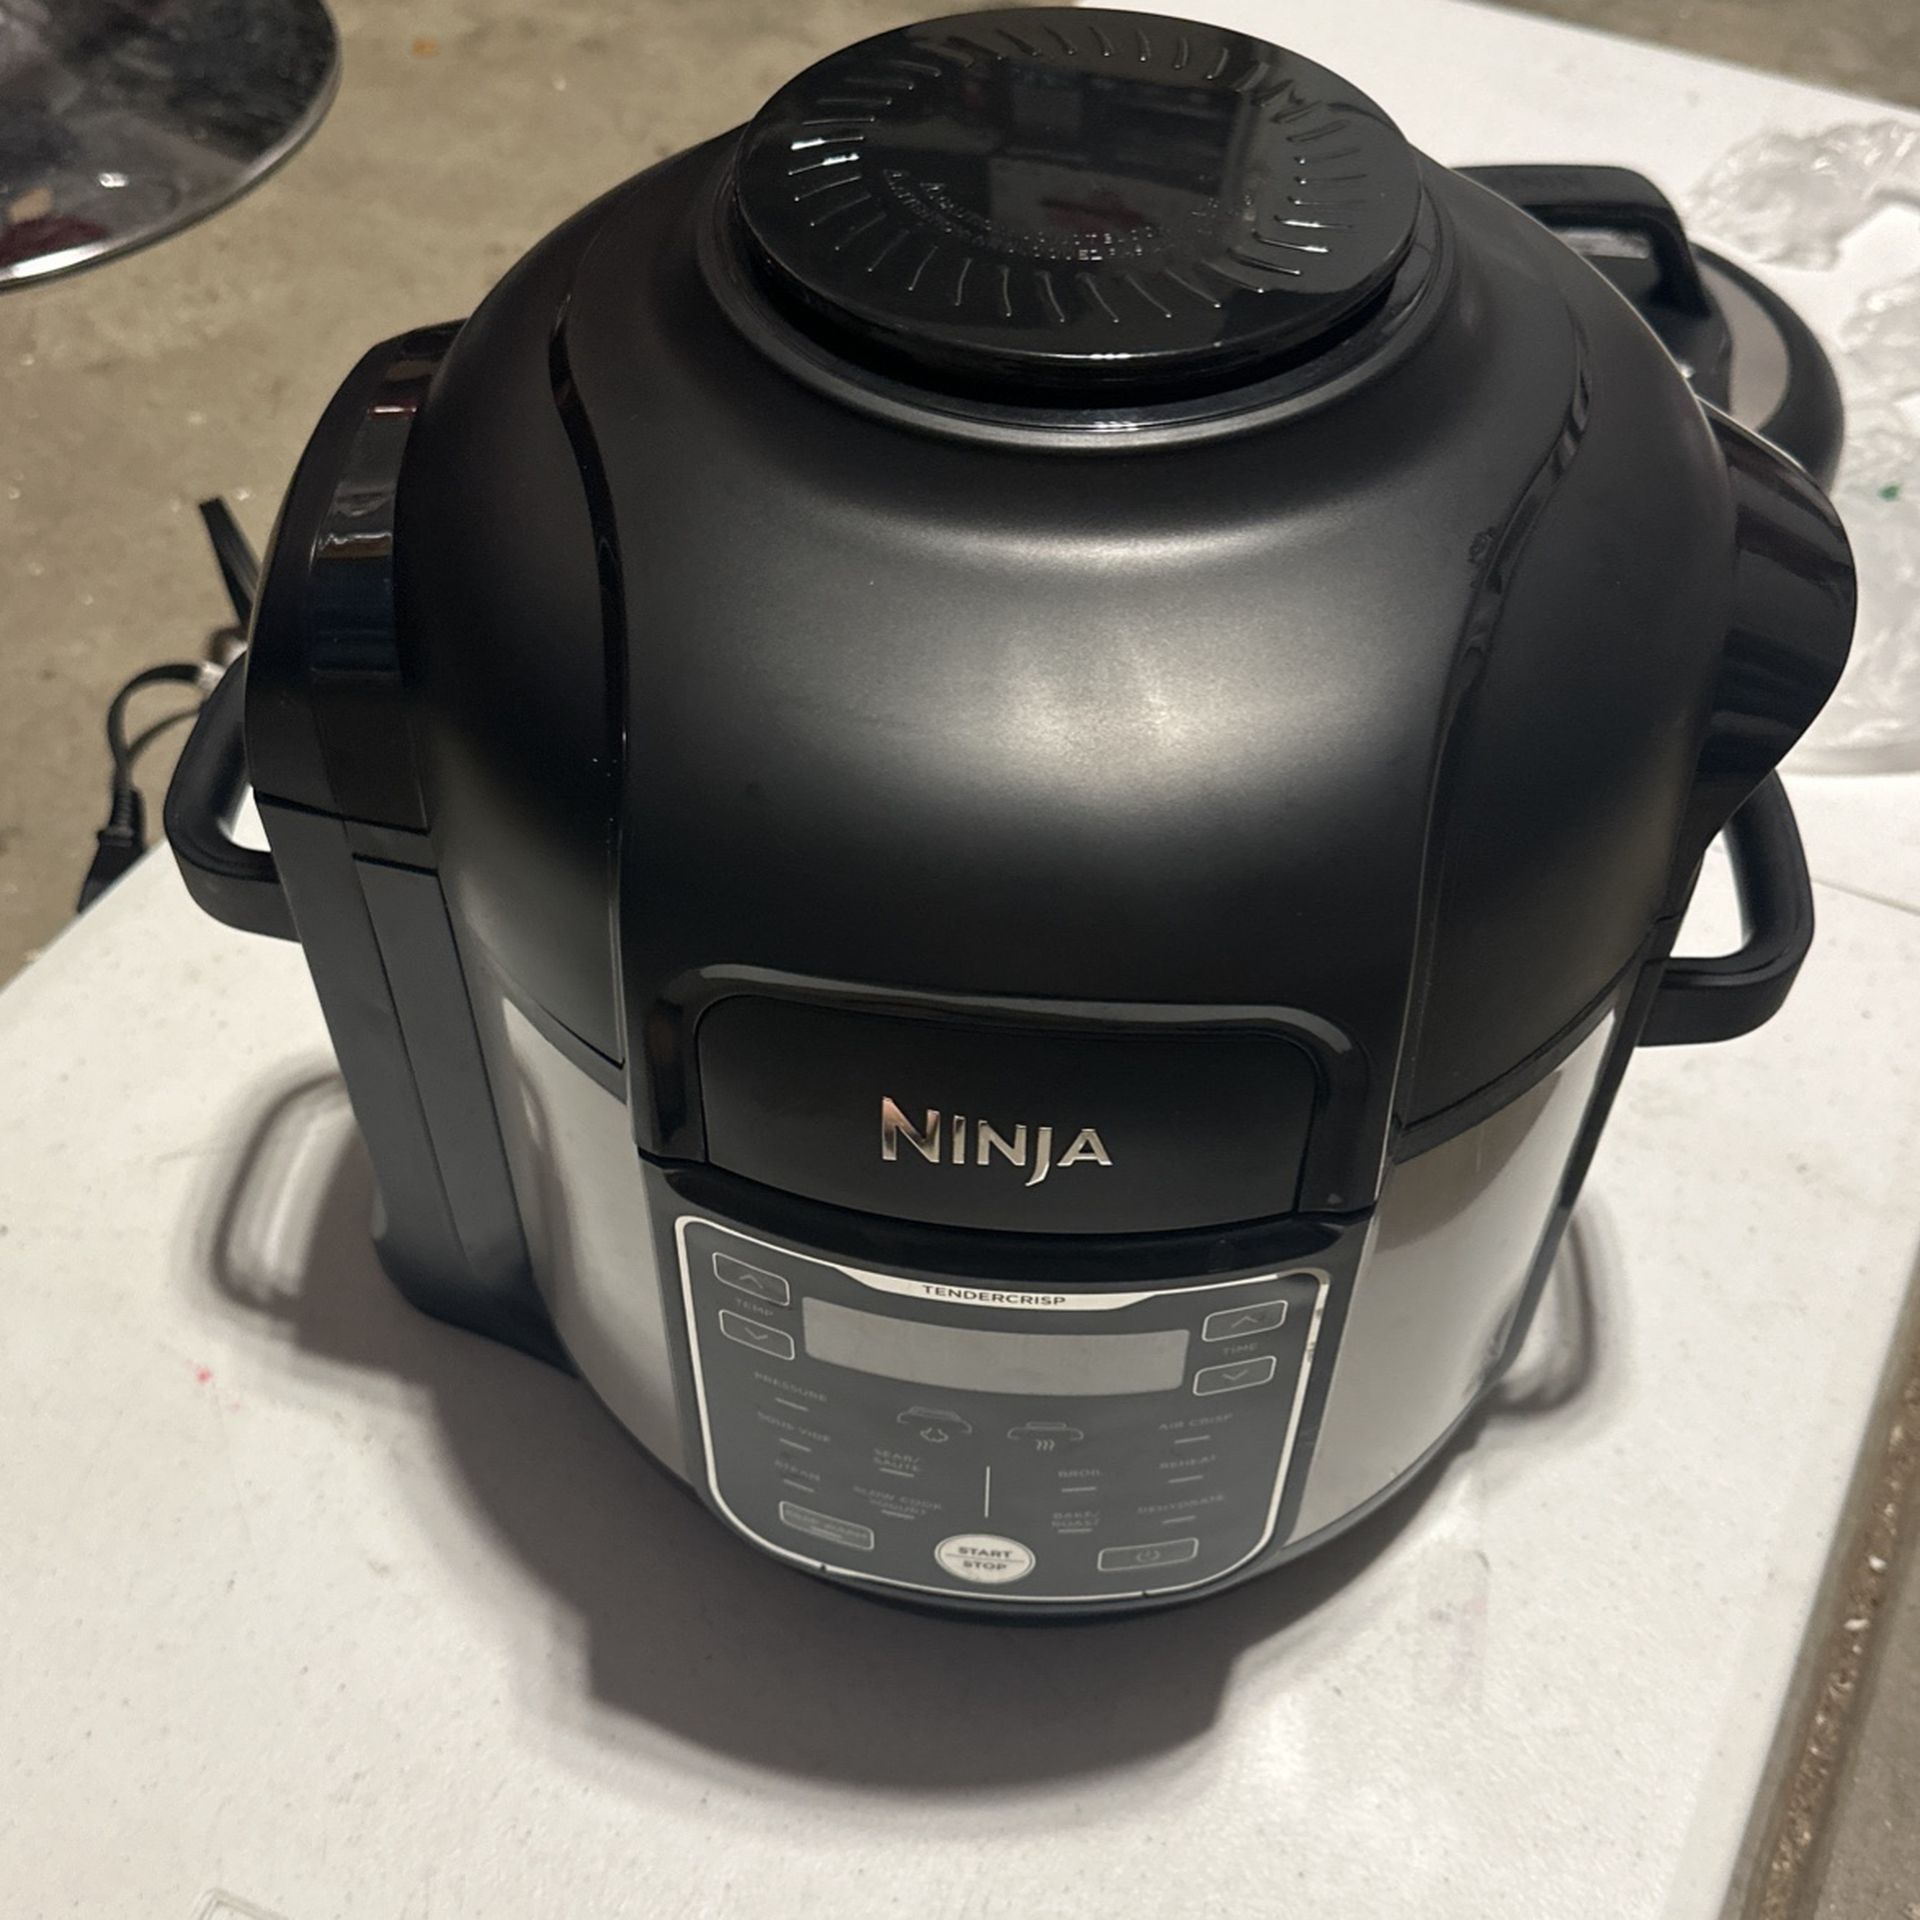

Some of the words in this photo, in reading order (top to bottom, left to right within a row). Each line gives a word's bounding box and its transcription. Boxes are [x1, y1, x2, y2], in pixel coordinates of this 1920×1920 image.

[880, 1096, 1114, 1187] NINJA
[922, 1284, 1067, 1305] TENDERCRISP
[1223, 1342, 1259, 1356] TIME
[958, 1546, 1014, 1558] START
[962, 1560, 1008, 1571] STOP
